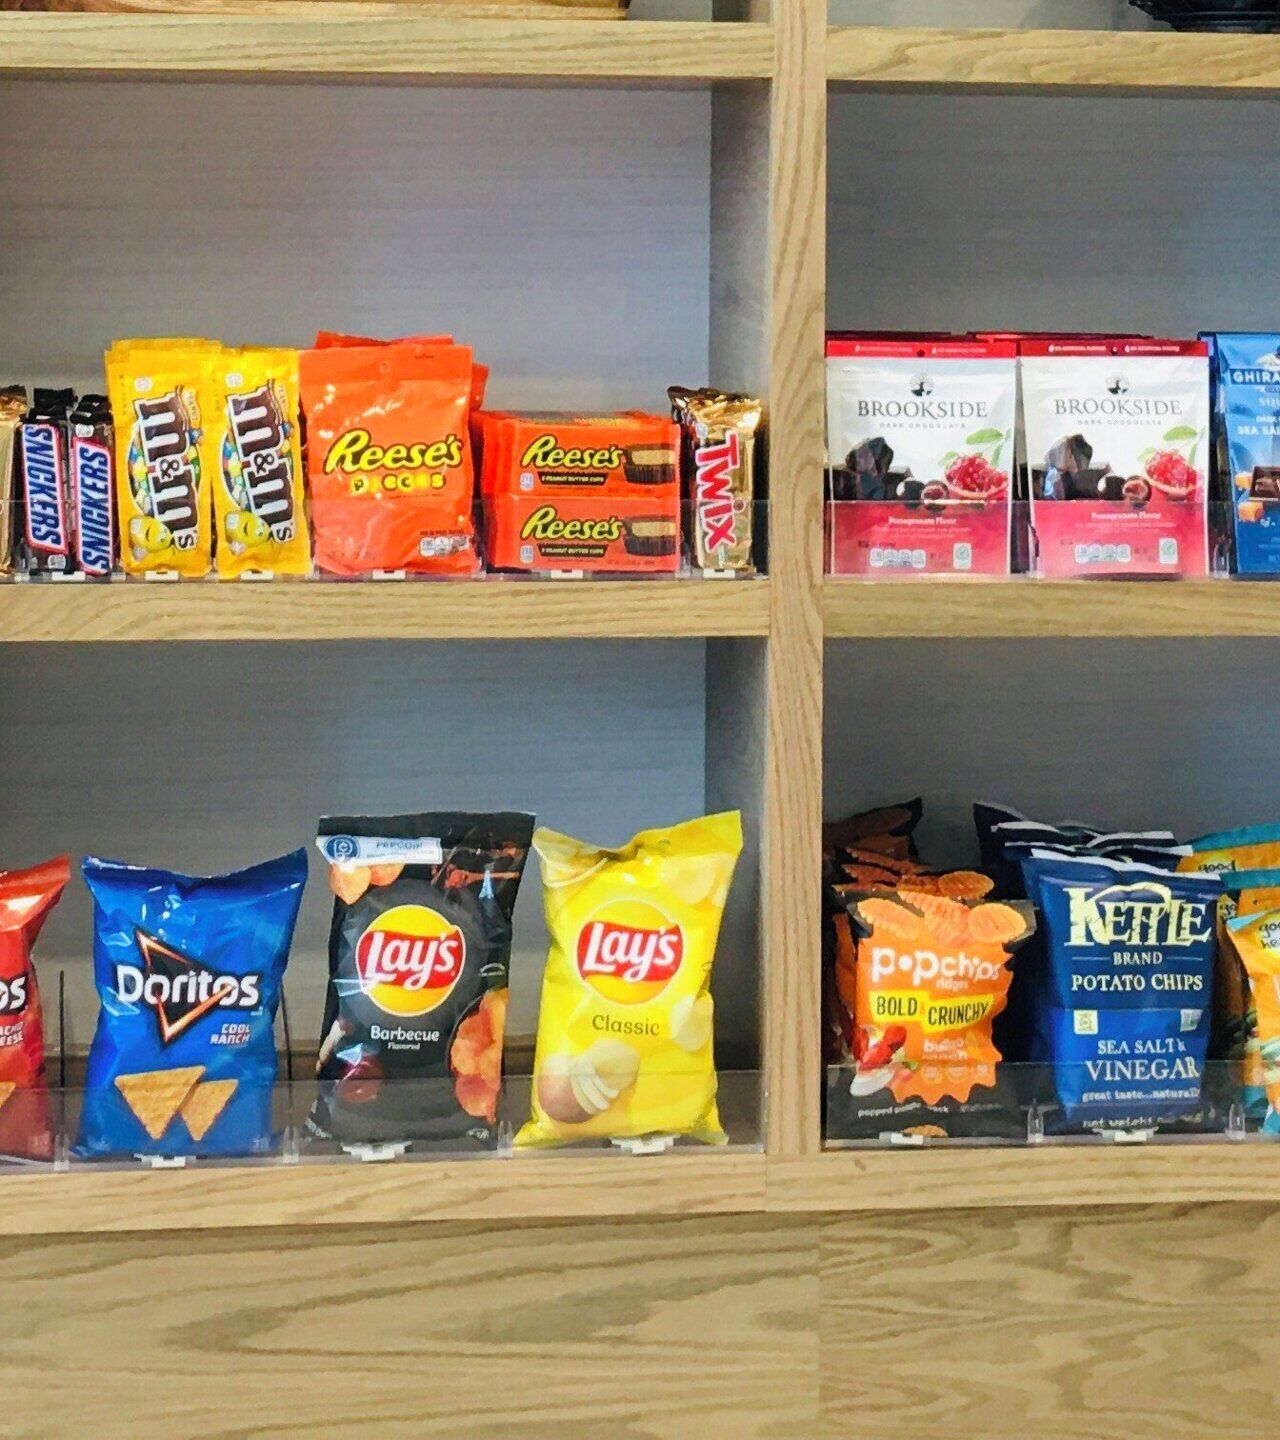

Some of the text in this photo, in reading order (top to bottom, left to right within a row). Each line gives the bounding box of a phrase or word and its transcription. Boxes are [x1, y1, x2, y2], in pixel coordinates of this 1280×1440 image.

[857, 399, 989, 418] BROOKSIDE
[1054, 398, 1183, 416] BROOKSIDE
[1237, 426, 1259, 436] SEA
[323, 429, 463, 474] Reese's
[520, 435, 623, 470] Reese's
[23, 424, 63, 546] SNICKERS
[78, 446, 108, 572] SNICKERS
[520, 505, 622, 541] Reese's
[1063, 881, 1213, 948] KETTLE
[359, 930, 459, 992] Lay's
[583, 921, 681, 984] Lay's
[1112, 951, 1163, 966] BRAND
[116, 964, 260, 1007] Doritos
[1070, 973, 1203, 993] POTATO CHIPS
[875, 994, 990, 1026] BOLD CRUNCHY
[369, 1025, 440, 1043] Barbecue
[591, 1013, 660, 1038] Classic
[209, 1034, 250, 1046] RANCH
[1097, 1038, 1174, 1055] SEA SALT
[1084, 1056, 1201, 1081] VINEGAR
